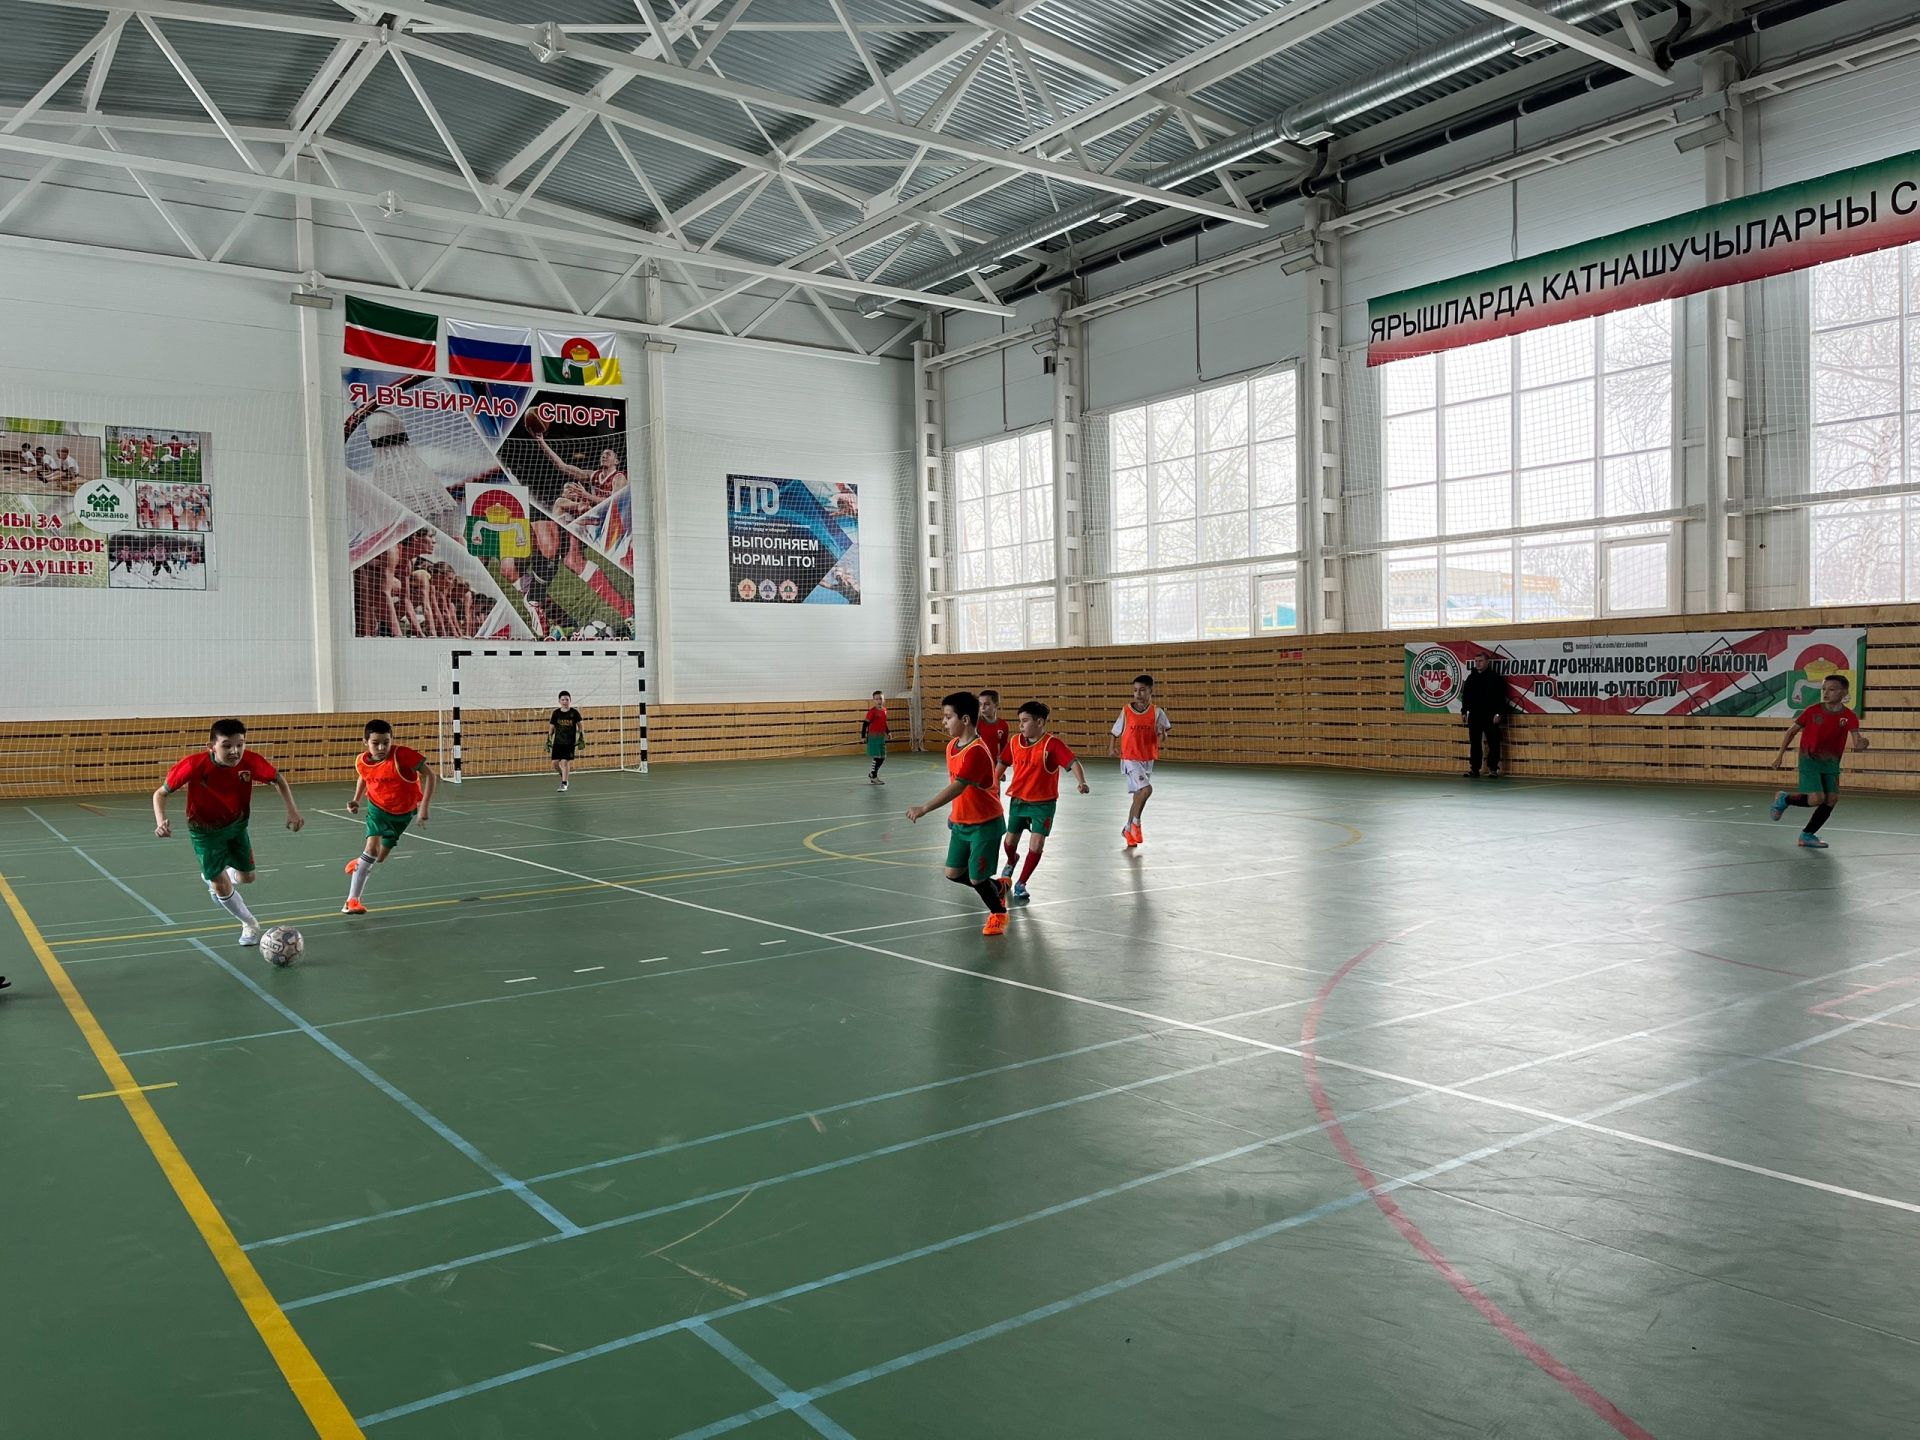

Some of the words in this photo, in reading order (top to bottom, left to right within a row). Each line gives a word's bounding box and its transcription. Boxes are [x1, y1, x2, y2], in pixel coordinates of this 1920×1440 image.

[1370, 281, 1534, 344] ЯРЫШЛАРДА
[1542, 190, 1877, 303] КАТНАШУЧЫЛАРНЫ
[1891, 180, 1918, 215] С
[349, 383, 369, 403] Я
[376, 386, 517, 418] ВЫБИРАЮ
[537, 403, 620, 428] СПОРТ
[734, 479, 780, 515] ГТО
[36, 513, 63, 529] ЗА
[80, 509, 129, 519] Дрожжаное
[732, 535, 819, 551] ВЫПОЛНЯЕМ
[732, 553, 784, 567] НОРМЫ
[788, 556, 815, 568] ГТО!
[1548, 655, 1698, 676] ДРОЖЖАНОВСКОГО
[1701, 651, 1768, 673] РАЙОНА
[1424, 670, 1448, 682] ЧДР
[1535, 681, 1553, 697] ПО
[1557, 680, 1678, 697] МИНИ-ФУТБОЛУ
